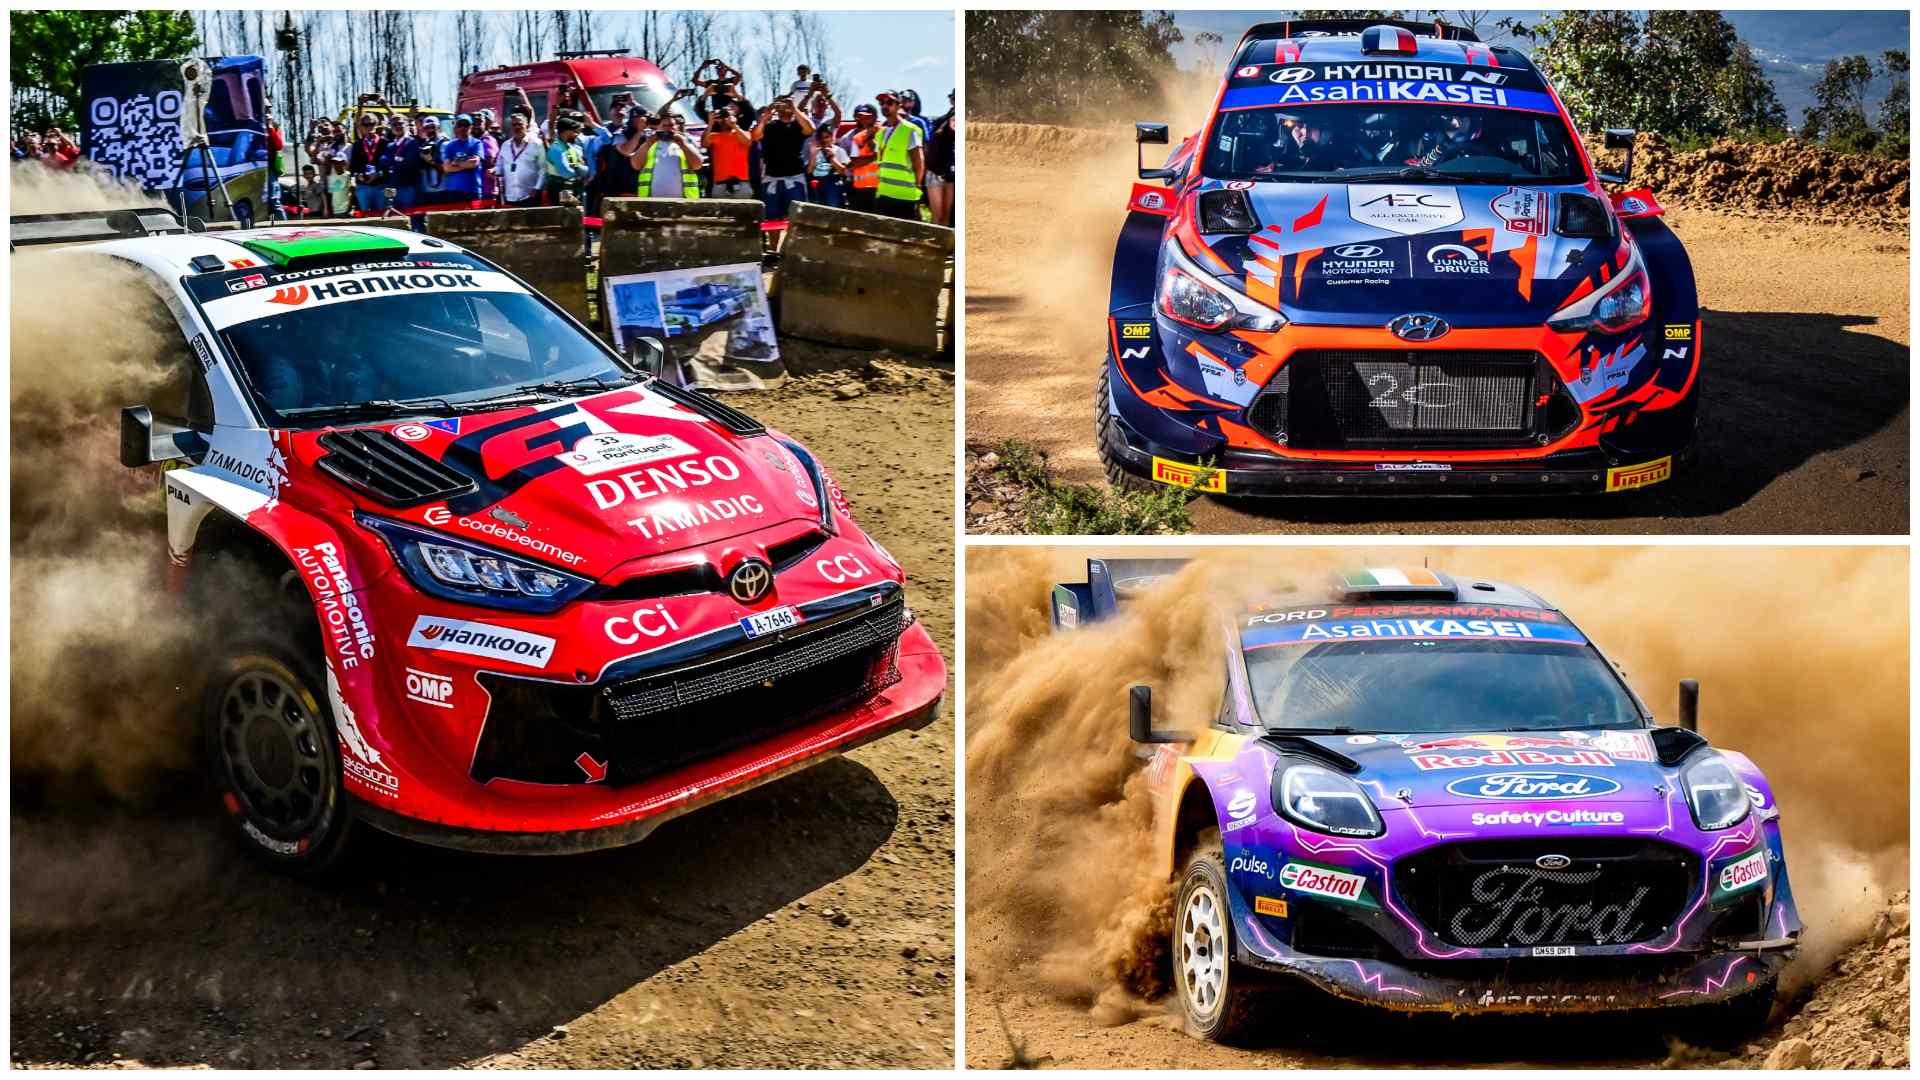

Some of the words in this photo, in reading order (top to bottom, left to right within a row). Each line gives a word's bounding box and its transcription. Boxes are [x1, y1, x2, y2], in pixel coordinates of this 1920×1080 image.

[1324, 65, 1451, 81] HYUNDAI
[270, 265, 348, 281] TOYOTA
[352, 261, 414, 273] GAZOO
[1322, 260, 1395, 268] HYUNDAI
[1322, 267, 1395, 275] MOTORSPORT
[1433, 259, 1489, 267] JUNIOR
[1434, 266, 1490, 275] DRIVER
[1122, 325, 1151, 338] OMP
[1665, 327, 1691, 339] OMP
[602, 443, 672, 460] Portugal
[208, 450, 265, 483] TAMADIC
[1156, 462, 1219, 489] PIREI
[1612, 462, 1668, 488] PIRELLI
[584, 455, 740, 510] DENSO
[168, 484, 191, 505] PIAA
[627, 495, 763, 540] TAMADIC
[459, 516, 583, 566] codebeamer
[294, 547, 358, 670] AUTOMOTIVE
[314, 541, 376, 660] Panasonic
[754, 611, 792, 633] A-7646
[1248, 609, 1328, 625] FORD
[1331, 606, 1558, 622] PERFORMANCE
[406, 673, 453, 701] OMP
[1411, 752, 1512, 770] Red
[1519, 751, 1616, 767] Bull
[1480, 774, 1590, 797] Ford
[1230, 855, 1268, 875] pulse
[1733, 858, 1767, 885] Castrol
[1296, 868, 1358, 897] Castrol
[1451, 866, 1652, 946] Ford
